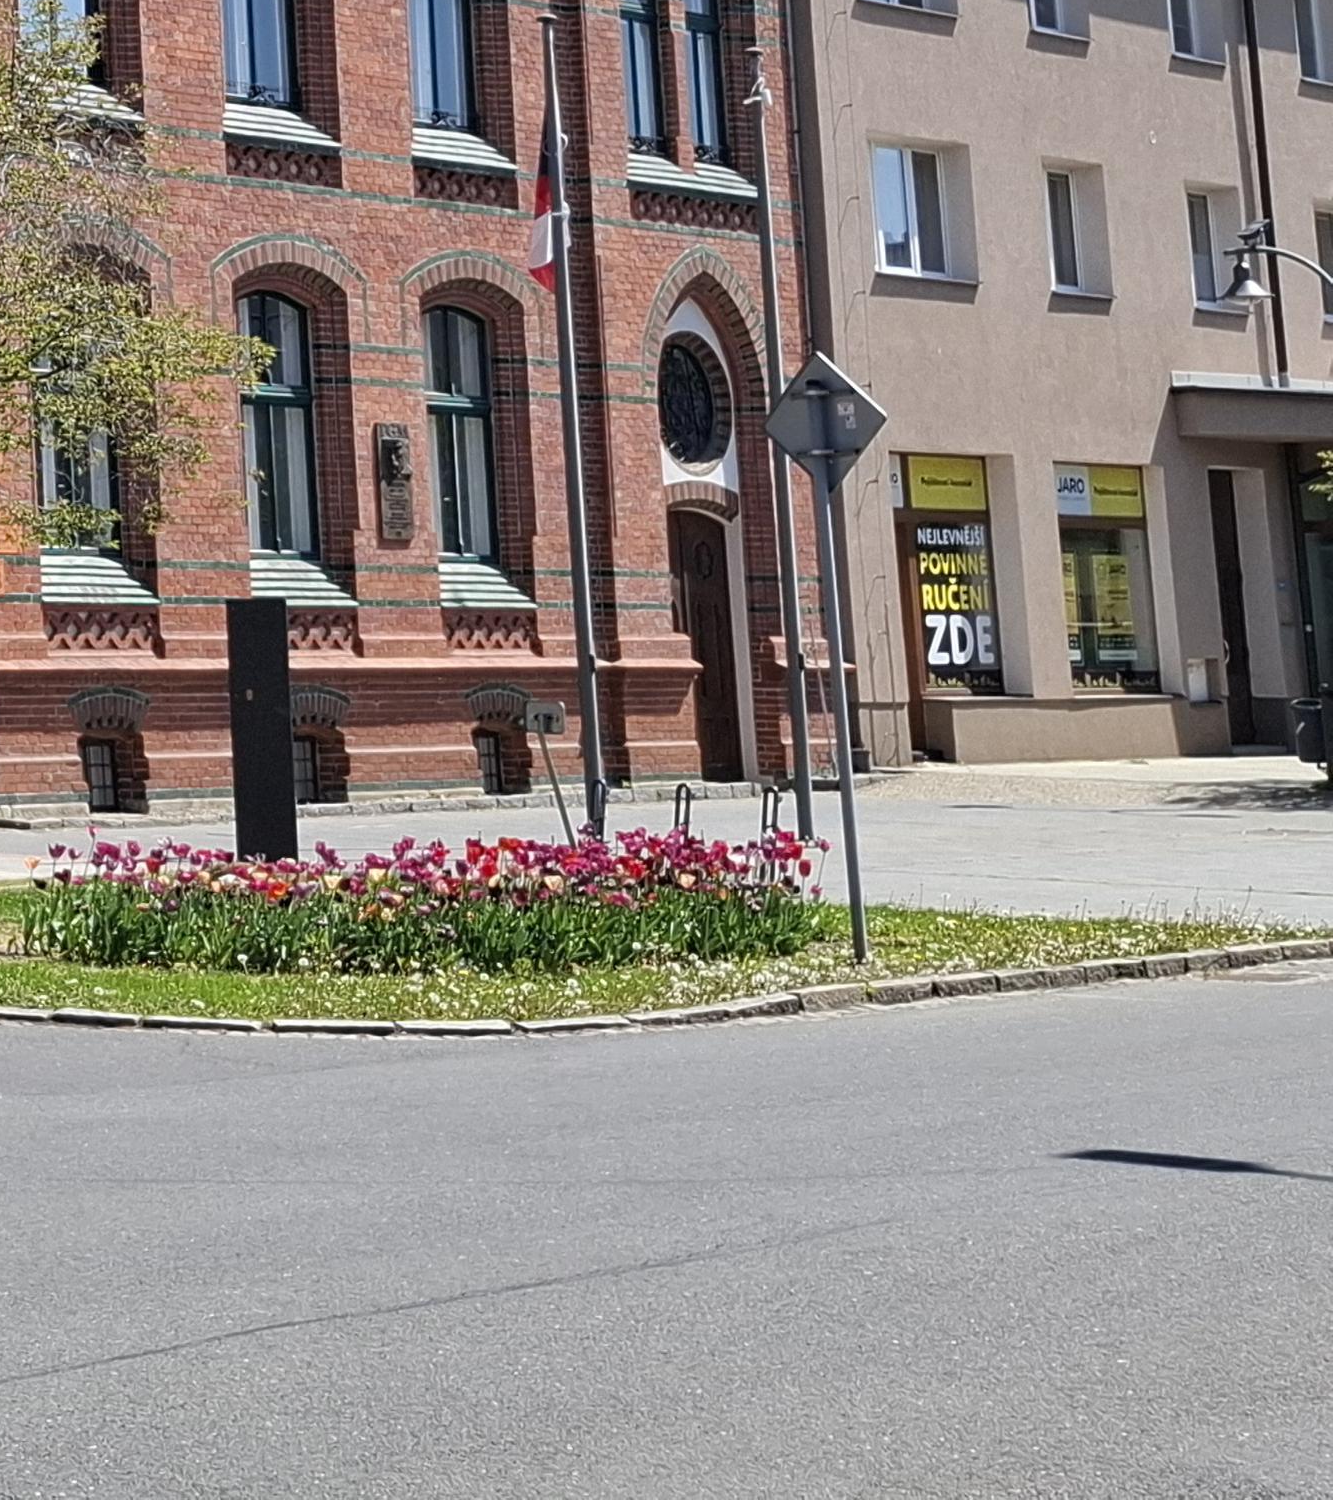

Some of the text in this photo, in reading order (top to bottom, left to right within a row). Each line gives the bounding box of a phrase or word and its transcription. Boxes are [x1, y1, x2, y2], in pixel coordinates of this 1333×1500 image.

[1057, 477, 1085, 494] JARO
[917, 525, 985, 545] NEJLEVNĚJŠÍ
[920, 549, 988, 575] POVINNÉ
[921, 577, 990, 610] RUČENÍ
[925, 614, 995, 665] ZDE
